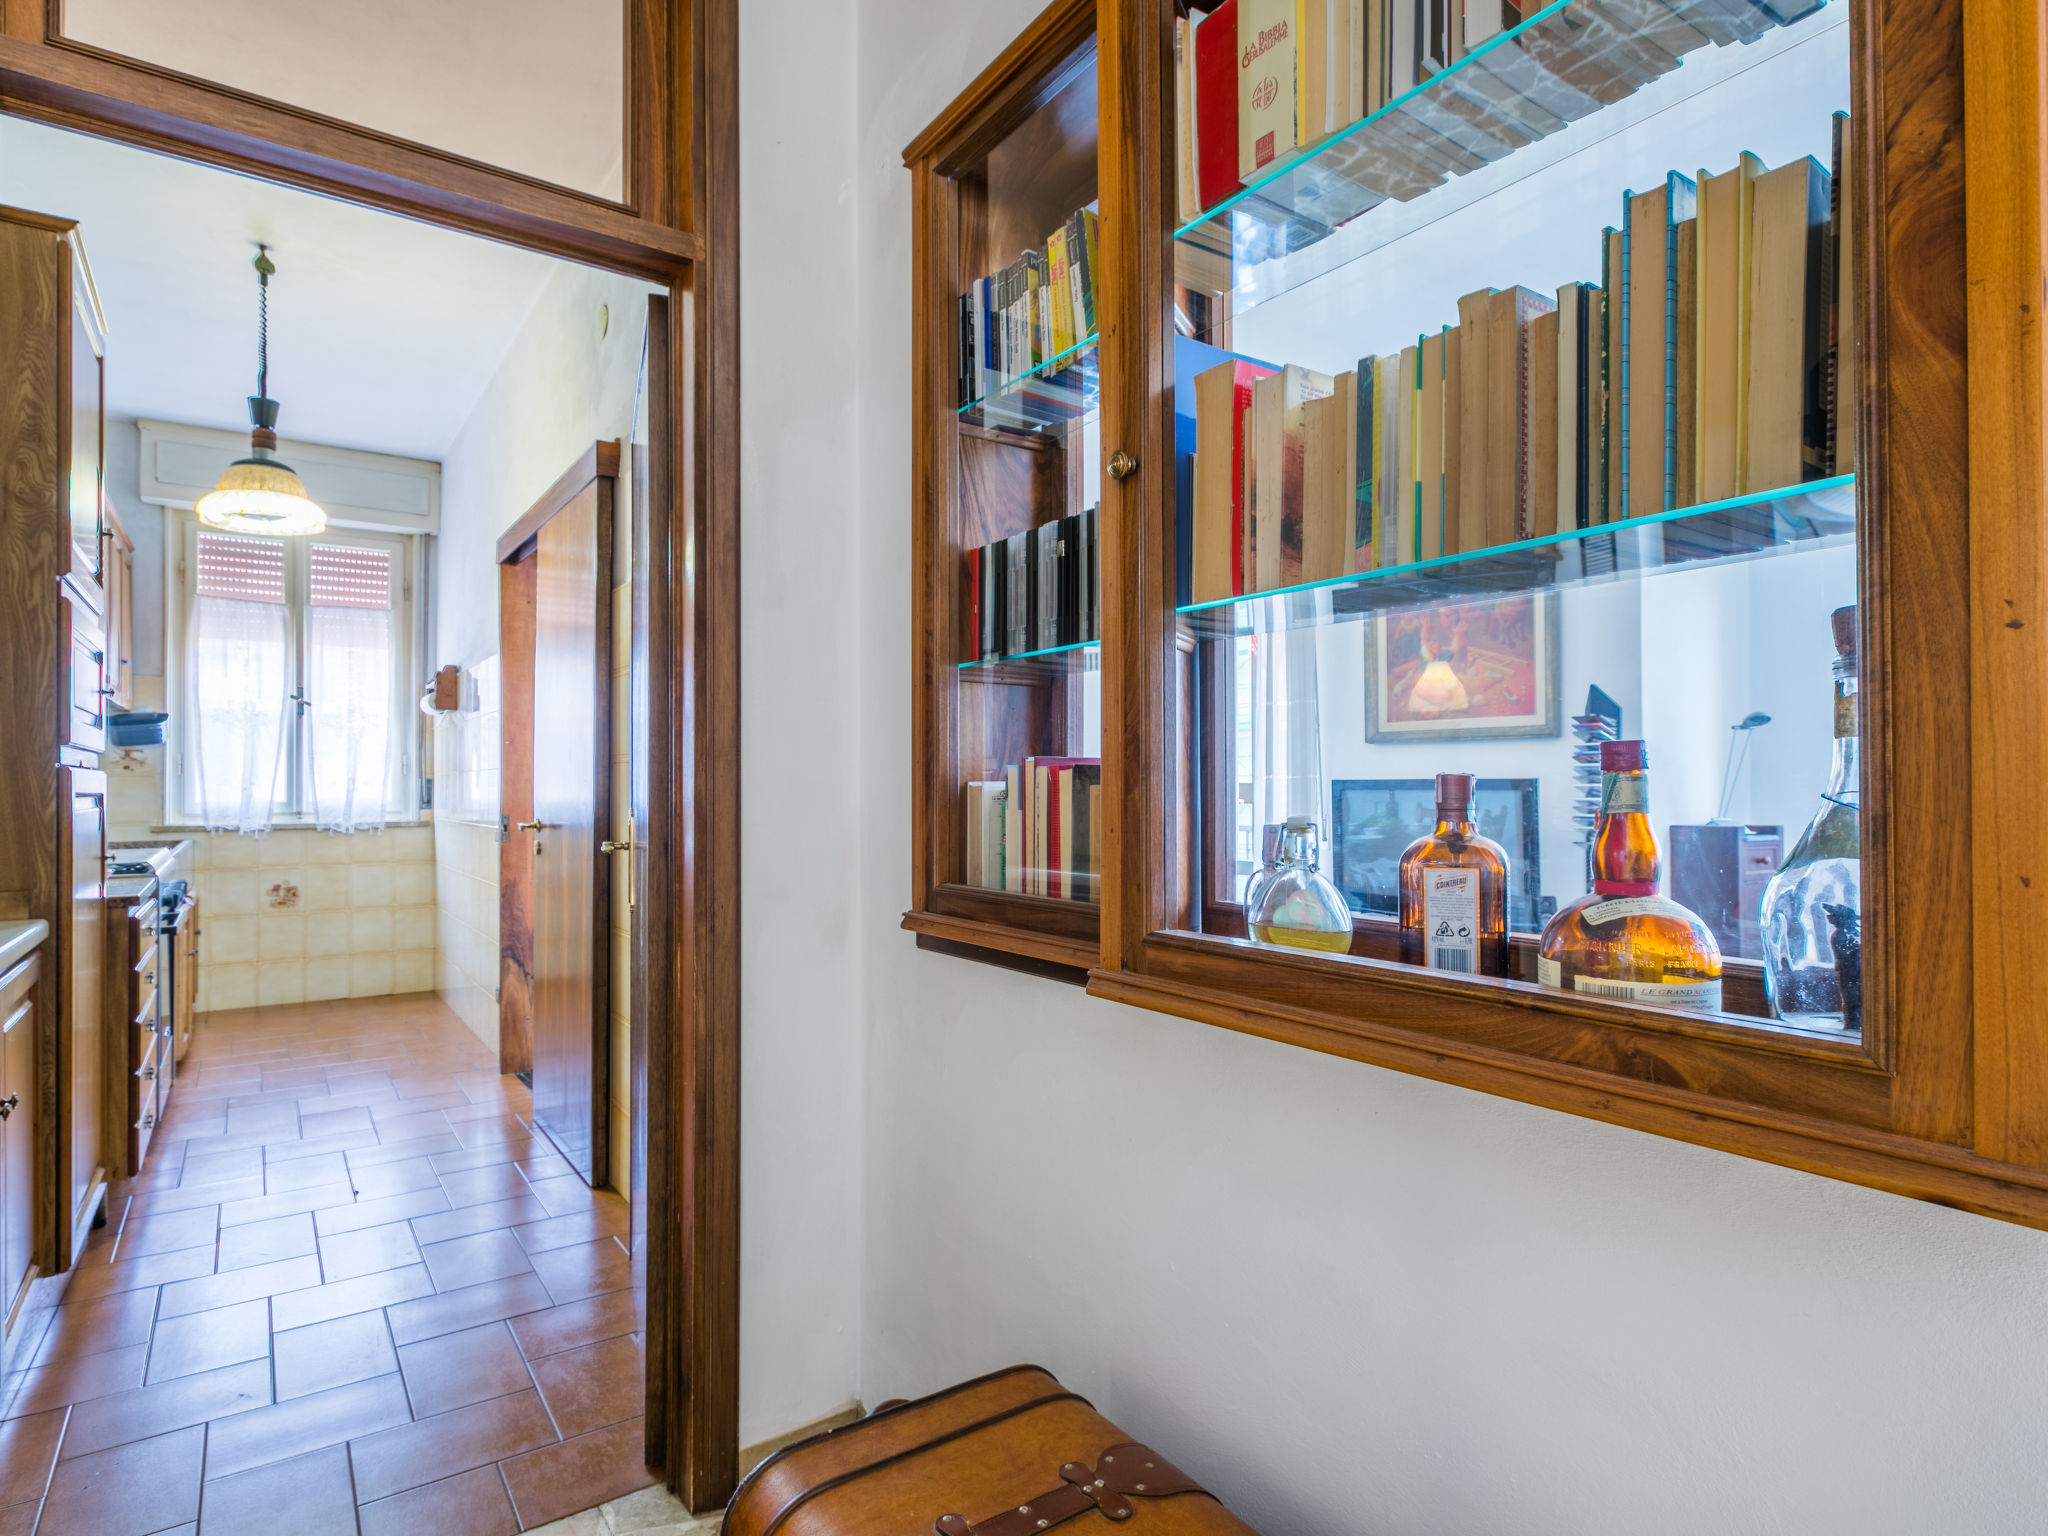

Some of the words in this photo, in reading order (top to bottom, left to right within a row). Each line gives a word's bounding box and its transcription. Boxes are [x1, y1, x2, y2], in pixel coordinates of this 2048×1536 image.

[1258, 19, 1288, 46] BIBBIA
[1241, 30, 1288, 69] GERUSALEMME
[1436, 877, 1467, 888] COINTREAU
[1657, 988, 1693, 996] GRAND
